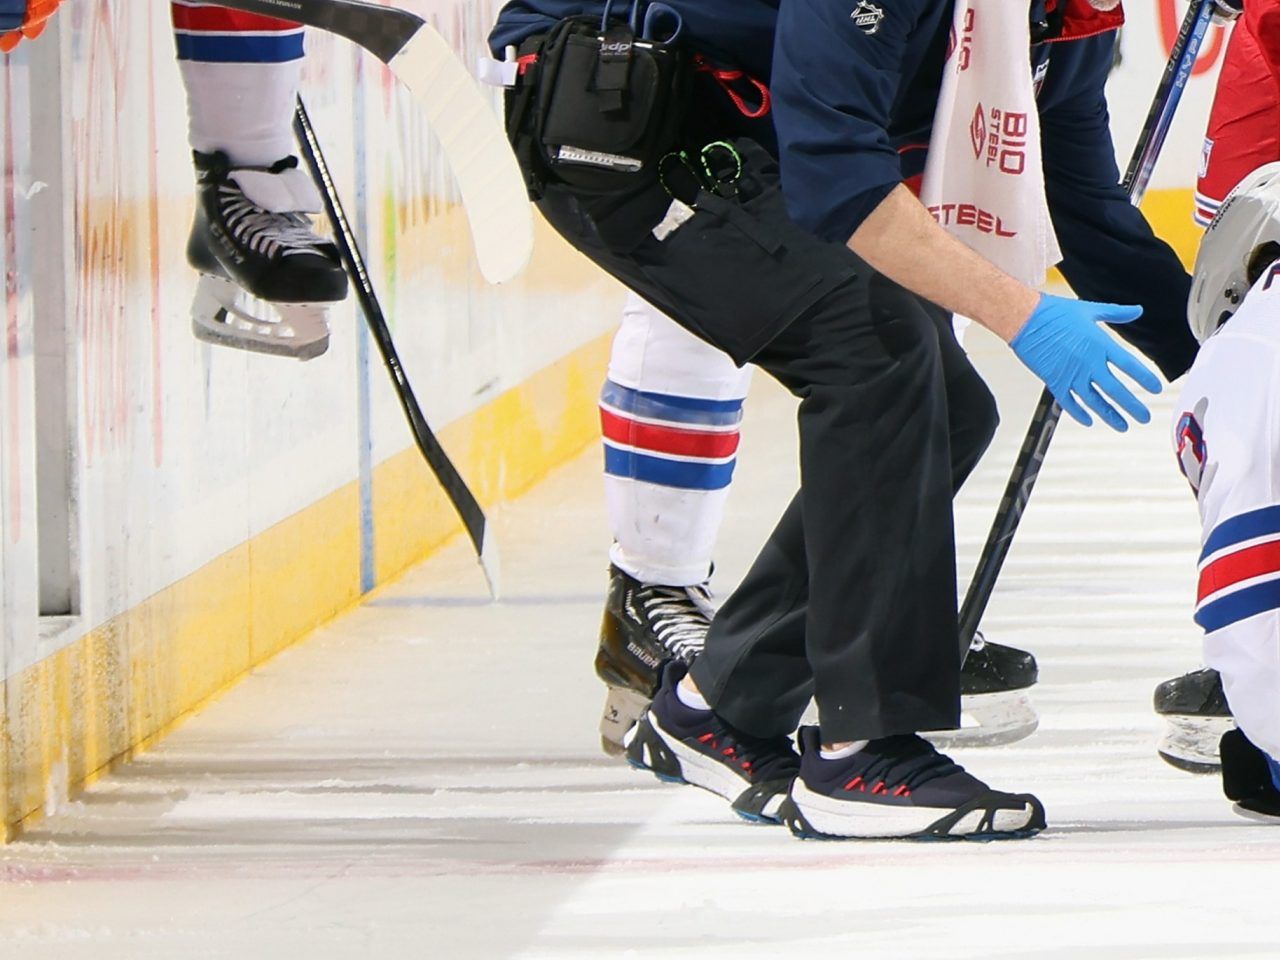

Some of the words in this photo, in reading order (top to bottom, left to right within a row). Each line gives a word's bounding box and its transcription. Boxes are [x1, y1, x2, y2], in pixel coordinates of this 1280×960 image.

[986, 106, 1001, 168] STEEL
[1000, 112, 1029, 176] BIO
[627, 641, 659, 670] BAUER
